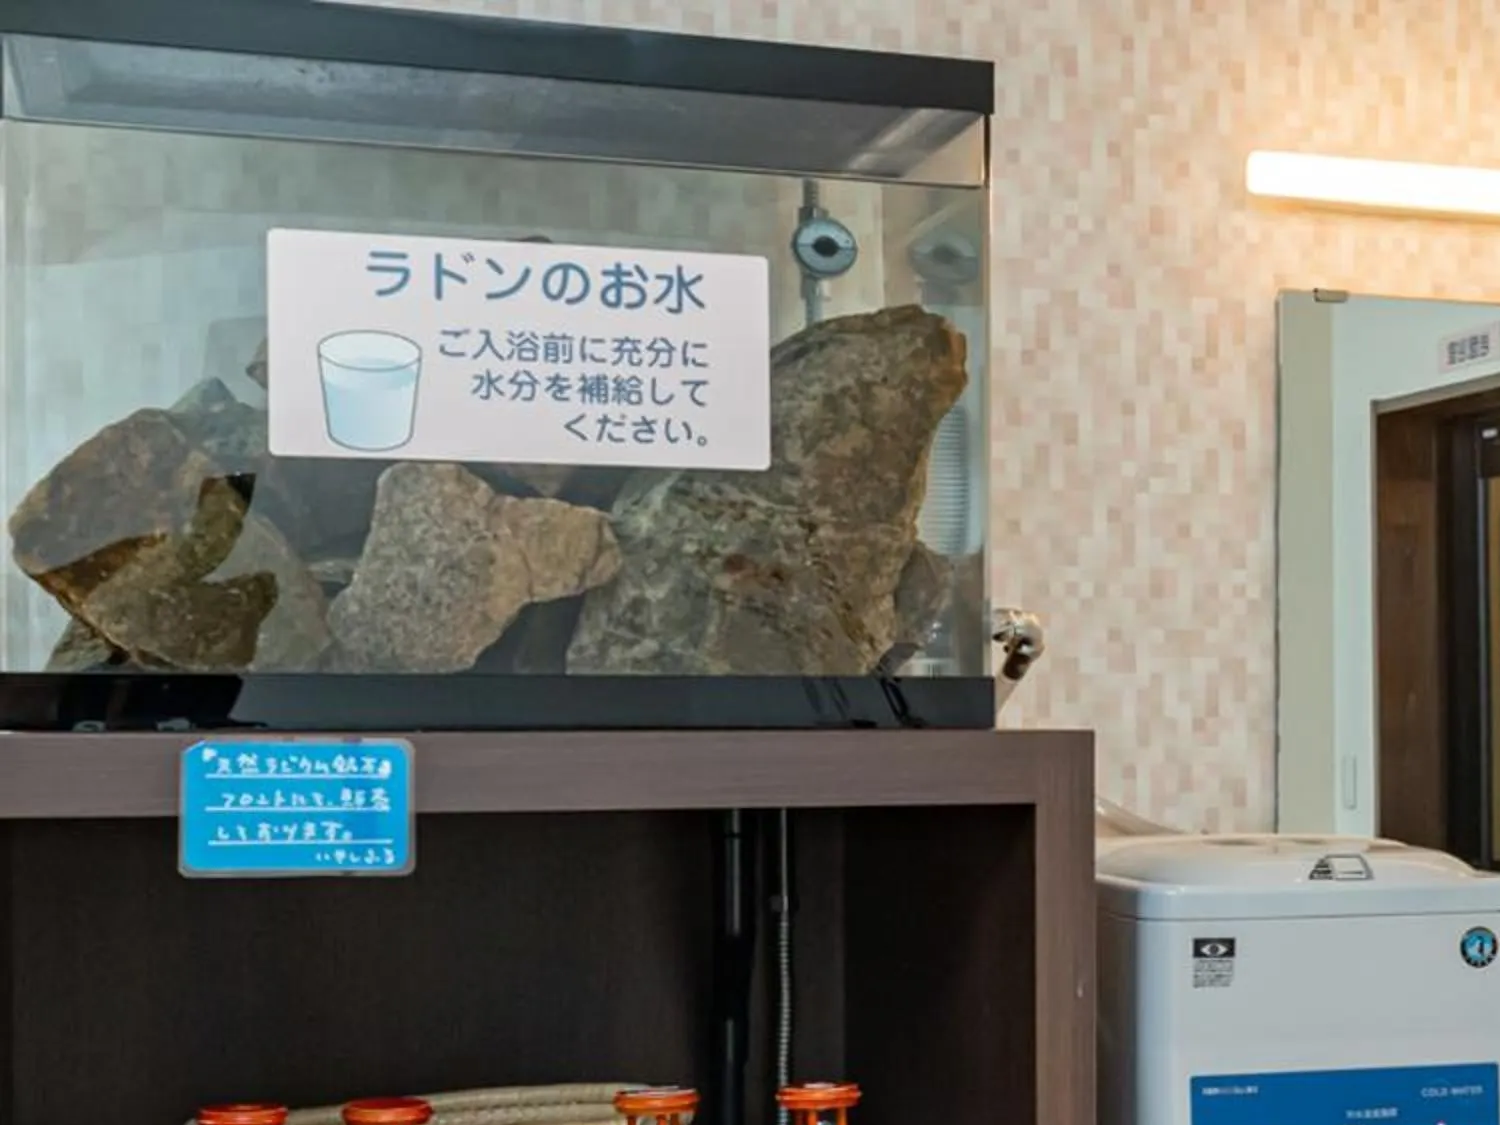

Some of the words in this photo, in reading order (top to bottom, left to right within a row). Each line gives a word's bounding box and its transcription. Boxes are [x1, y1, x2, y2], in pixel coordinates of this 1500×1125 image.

[366, 249, 707, 315] ラドンのお水
[438, 328, 709, 369] ご入浴前に充分に
[470, 369, 709, 408] 水分を補給して
[563, 413, 709, 447] ください。
